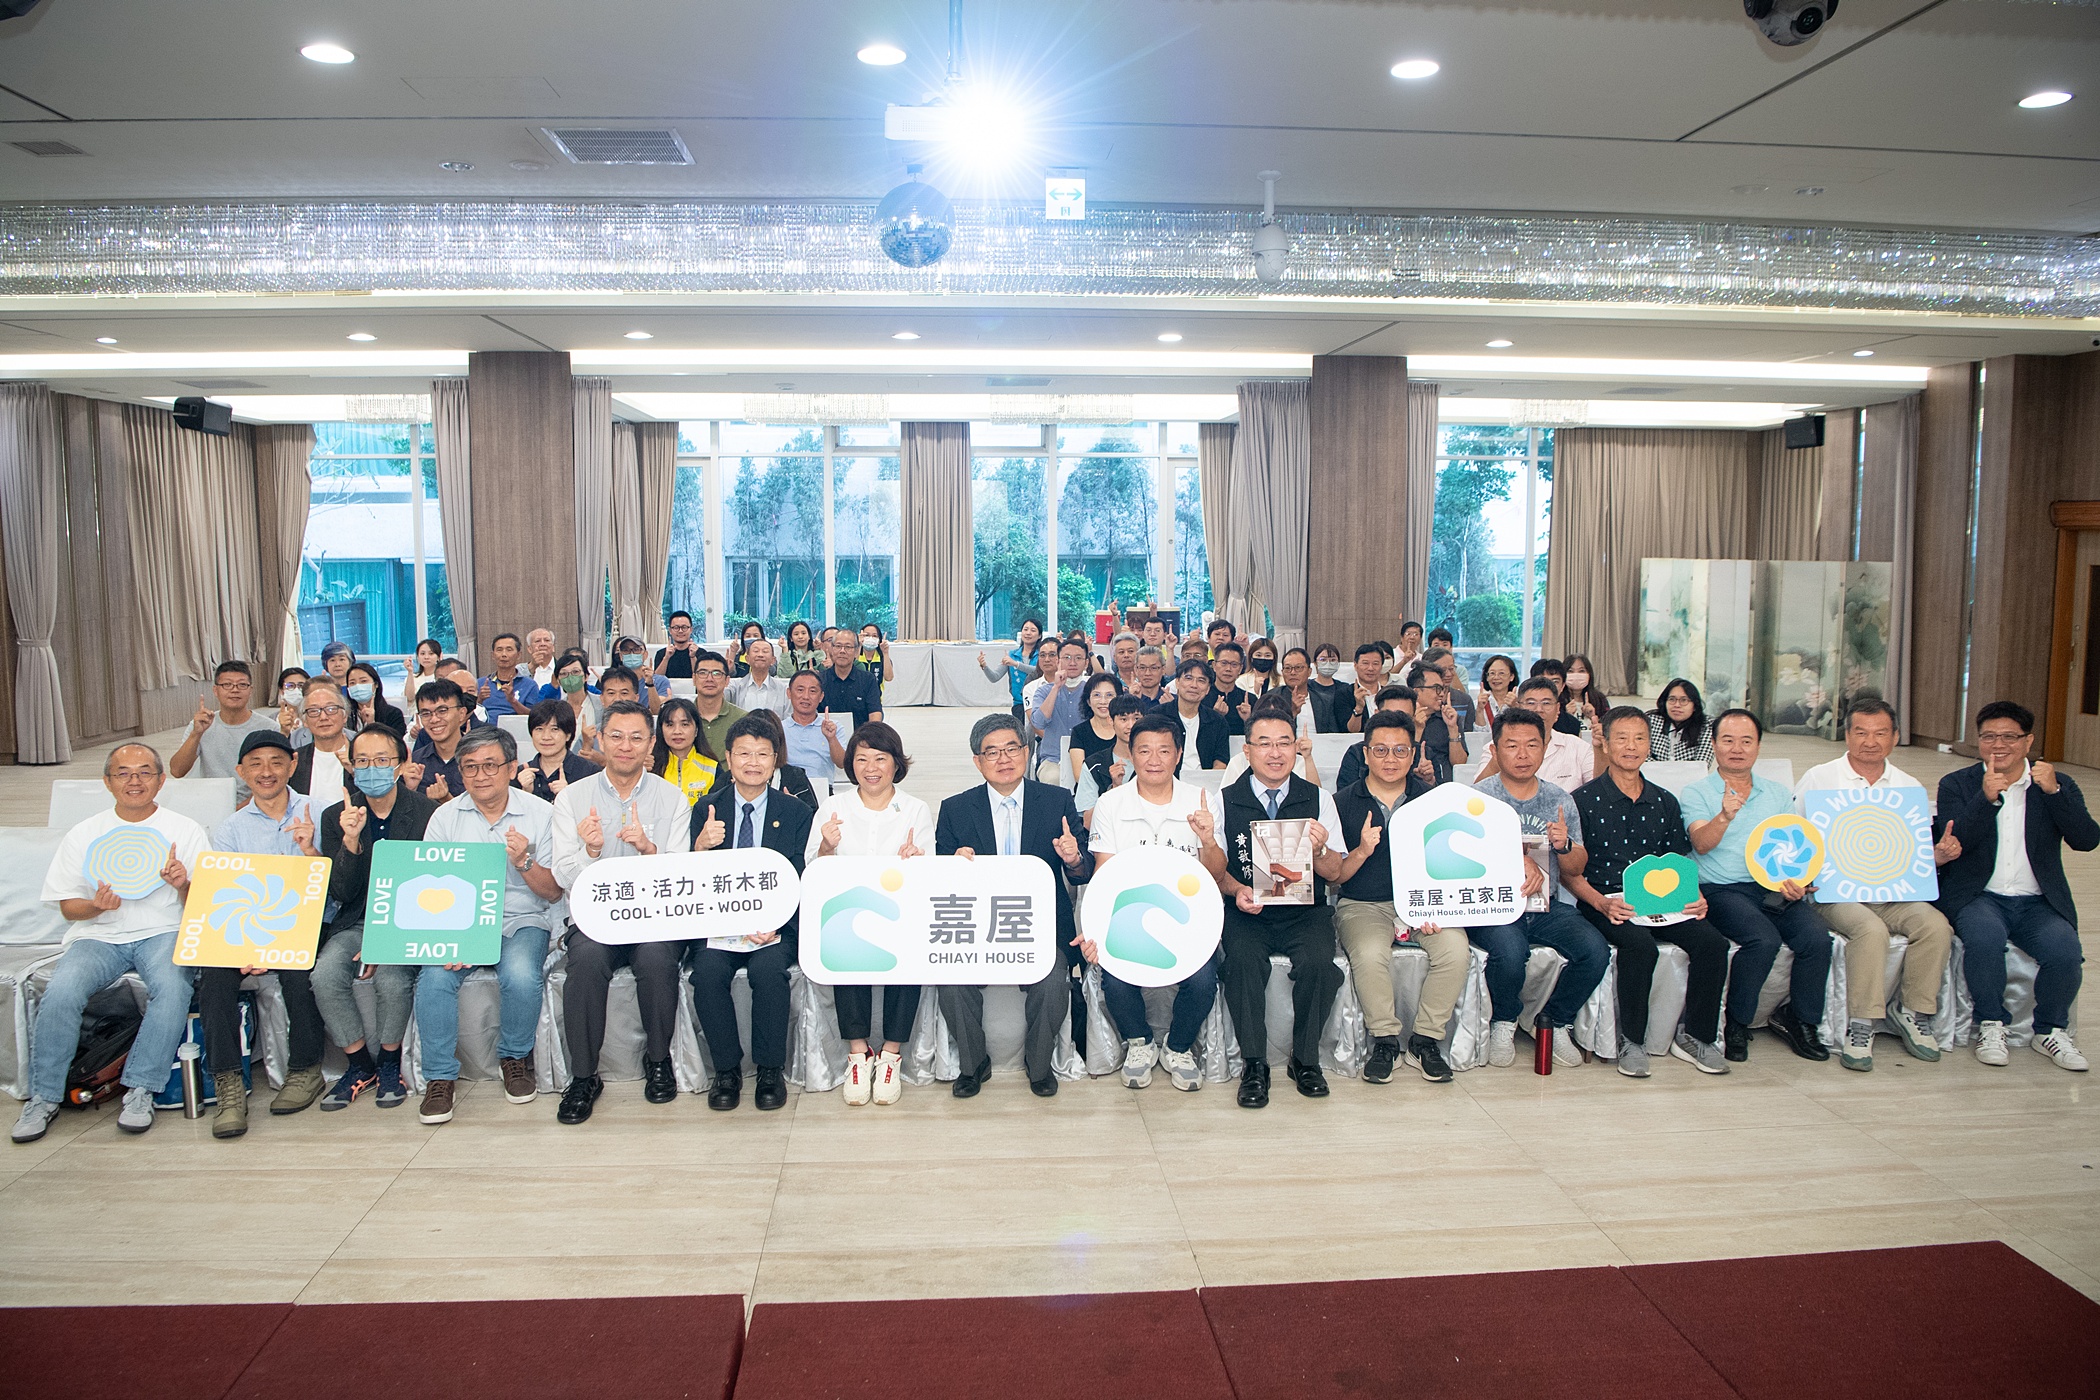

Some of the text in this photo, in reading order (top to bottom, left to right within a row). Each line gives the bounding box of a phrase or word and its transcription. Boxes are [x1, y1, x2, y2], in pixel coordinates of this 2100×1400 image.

[1825, 788, 1904, 812] WOOD
[1904, 805, 1935, 878] WOOD
[201, 855, 256, 871] COOL
[414, 847, 466, 863] LOVE
[303, 861, 326, 905] COOL
[1836, 879, 1917, 902] WOOD
[371, 877, 394, 925] LOVE
[479, 879, 499, 926] LOVE
[1408, 909, 1435, 918] Chiayi
[1468, 907, 1489, 915] Ideal
[1490, 906, 1515, 914] Home
[928, 893, 1035, 944] 嘉屋
[179, 913, 206, 961] COOL
[254, 948, 310, 965] COOL
[405, 942, 459, 958] LOVE
[928, 952, 1035, 964] CHIAYI HOUSE
